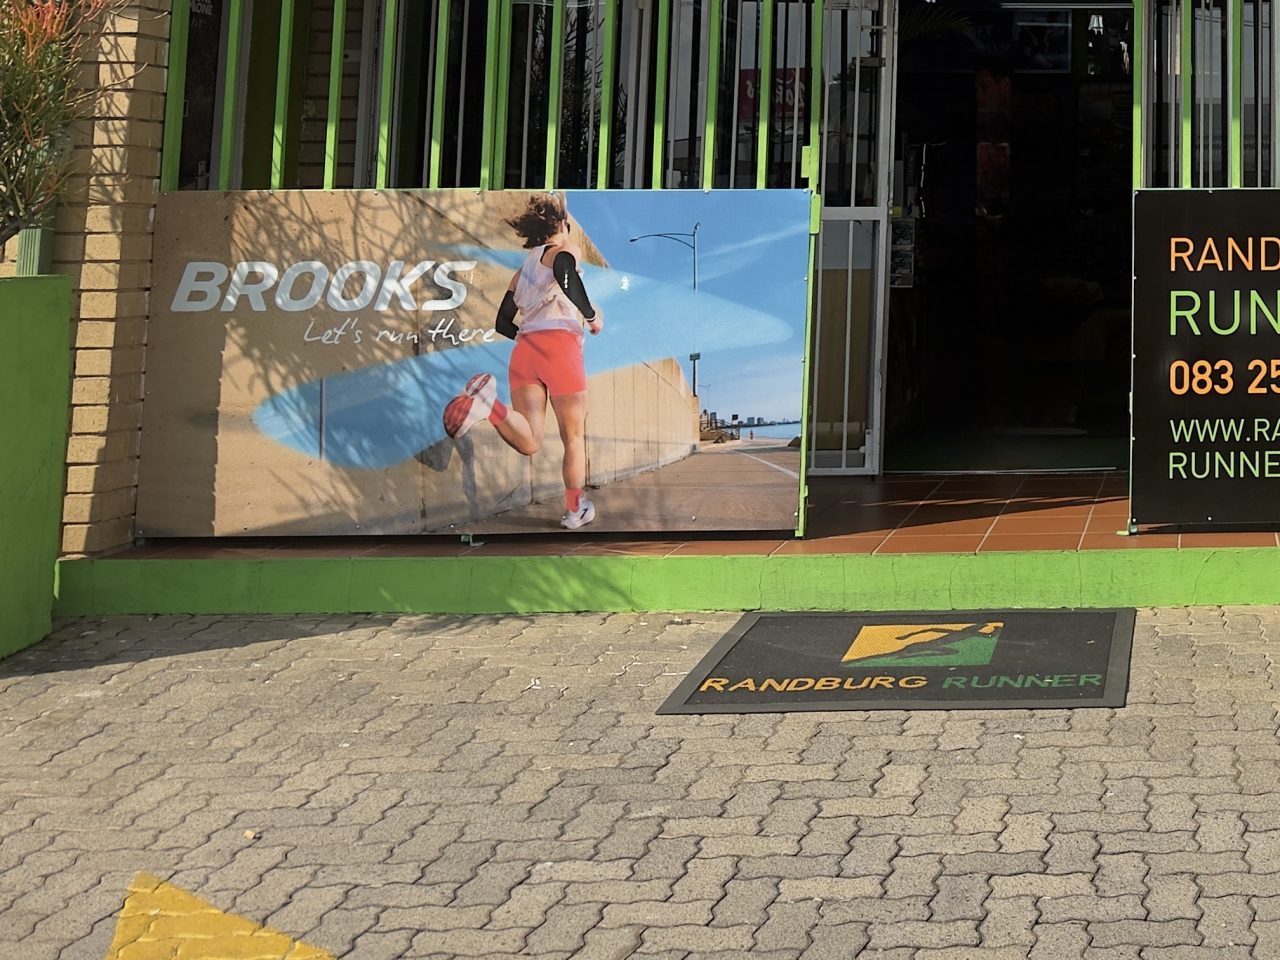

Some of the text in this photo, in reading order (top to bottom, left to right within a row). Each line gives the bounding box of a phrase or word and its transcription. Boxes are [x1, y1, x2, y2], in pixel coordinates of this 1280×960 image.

[170, 260, 478, 312] BROOKS
[303, 316, 496, 346] Let's run there
[1169, 359, 1234, 395] 083
[699, 673, 1103, 693] RANDBURG RUNNER
